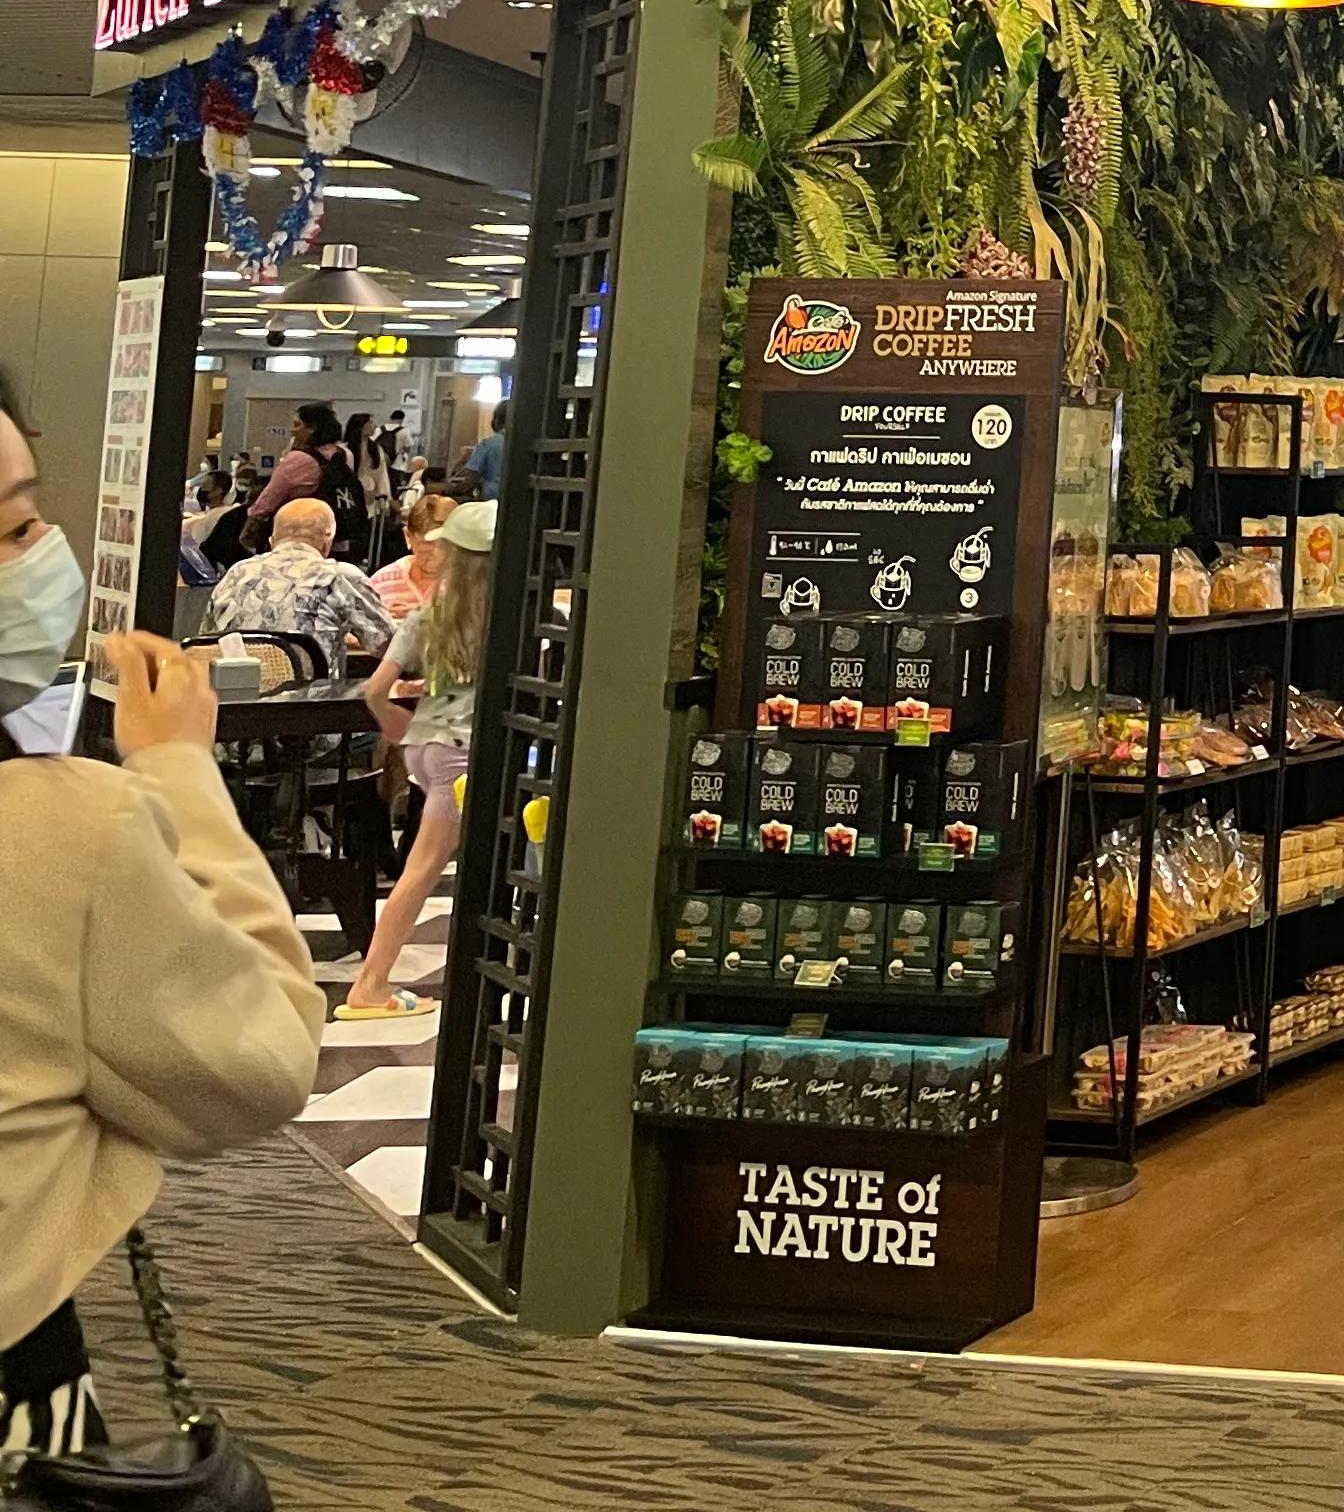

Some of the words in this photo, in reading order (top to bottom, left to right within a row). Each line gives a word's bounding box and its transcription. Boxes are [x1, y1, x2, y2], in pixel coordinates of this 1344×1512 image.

[945, 290, 988, 302] Amazon
[989, 290, 1038, 304] Signature
[874, 304, 945, 331] DRIP
[944, 304, 1037, 332] FRESH
[873, 333, 973, 357] COFFEE
[919, 359, 1018, 376] ANYWHERE
[840, 405, 879, 422] DRIP
[883, 406, 947, 423] COFFEE
[976, 418, 1007, 436] 120
[842, 478, 901, 493] Amazon
[766, 660, 799, 674] COLD
[830, 662, 863, 675] COLD
[896, 663, 930, 676] COLD
[766, 674, 799, 686] BREW
[830, 675, 864, 688] BREW
[896, 676, 931, 689] BREW
[690, 776, 723, 790] COLD
[690, 789, 723, 802] BREW
[760, 784, 794, 799] COLD
[825, 788, 858, 803] COLD
[945, 786, 979, 800] COLD
[760, 798, 794, 811] BREW
[825, 802, 858, 815] BREW
[945, 800, 980, 812] BREW
[739, 1162, 885, 1210] TASTE
[898, 1173, 942, 1215] of
[734, 1209, 938, 1267] NATURE
